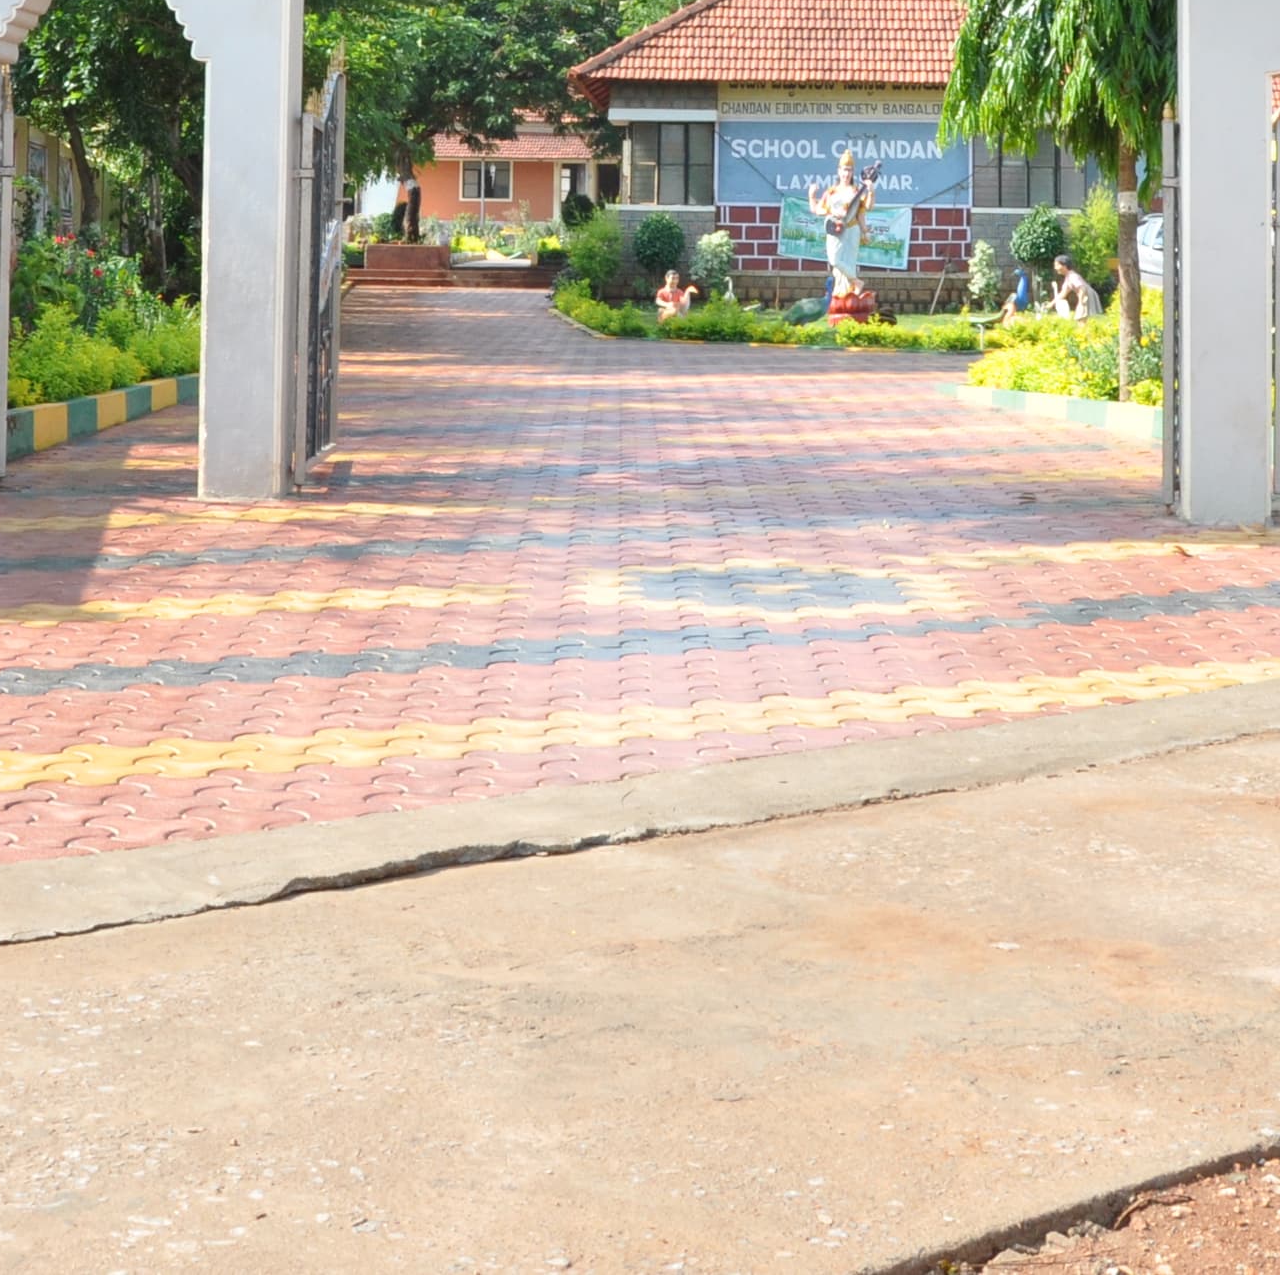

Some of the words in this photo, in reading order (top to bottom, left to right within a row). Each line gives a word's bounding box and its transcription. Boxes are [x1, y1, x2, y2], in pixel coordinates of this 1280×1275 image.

[721, 102, 771, 115] CHANDAN
[775, 102, 832, 115] EDUCATION
[836, 103, 878, 115] SOCIETY
[882, 103, 943, 116] BANGALO
[831, 139, 943, 160] CHANDAN
